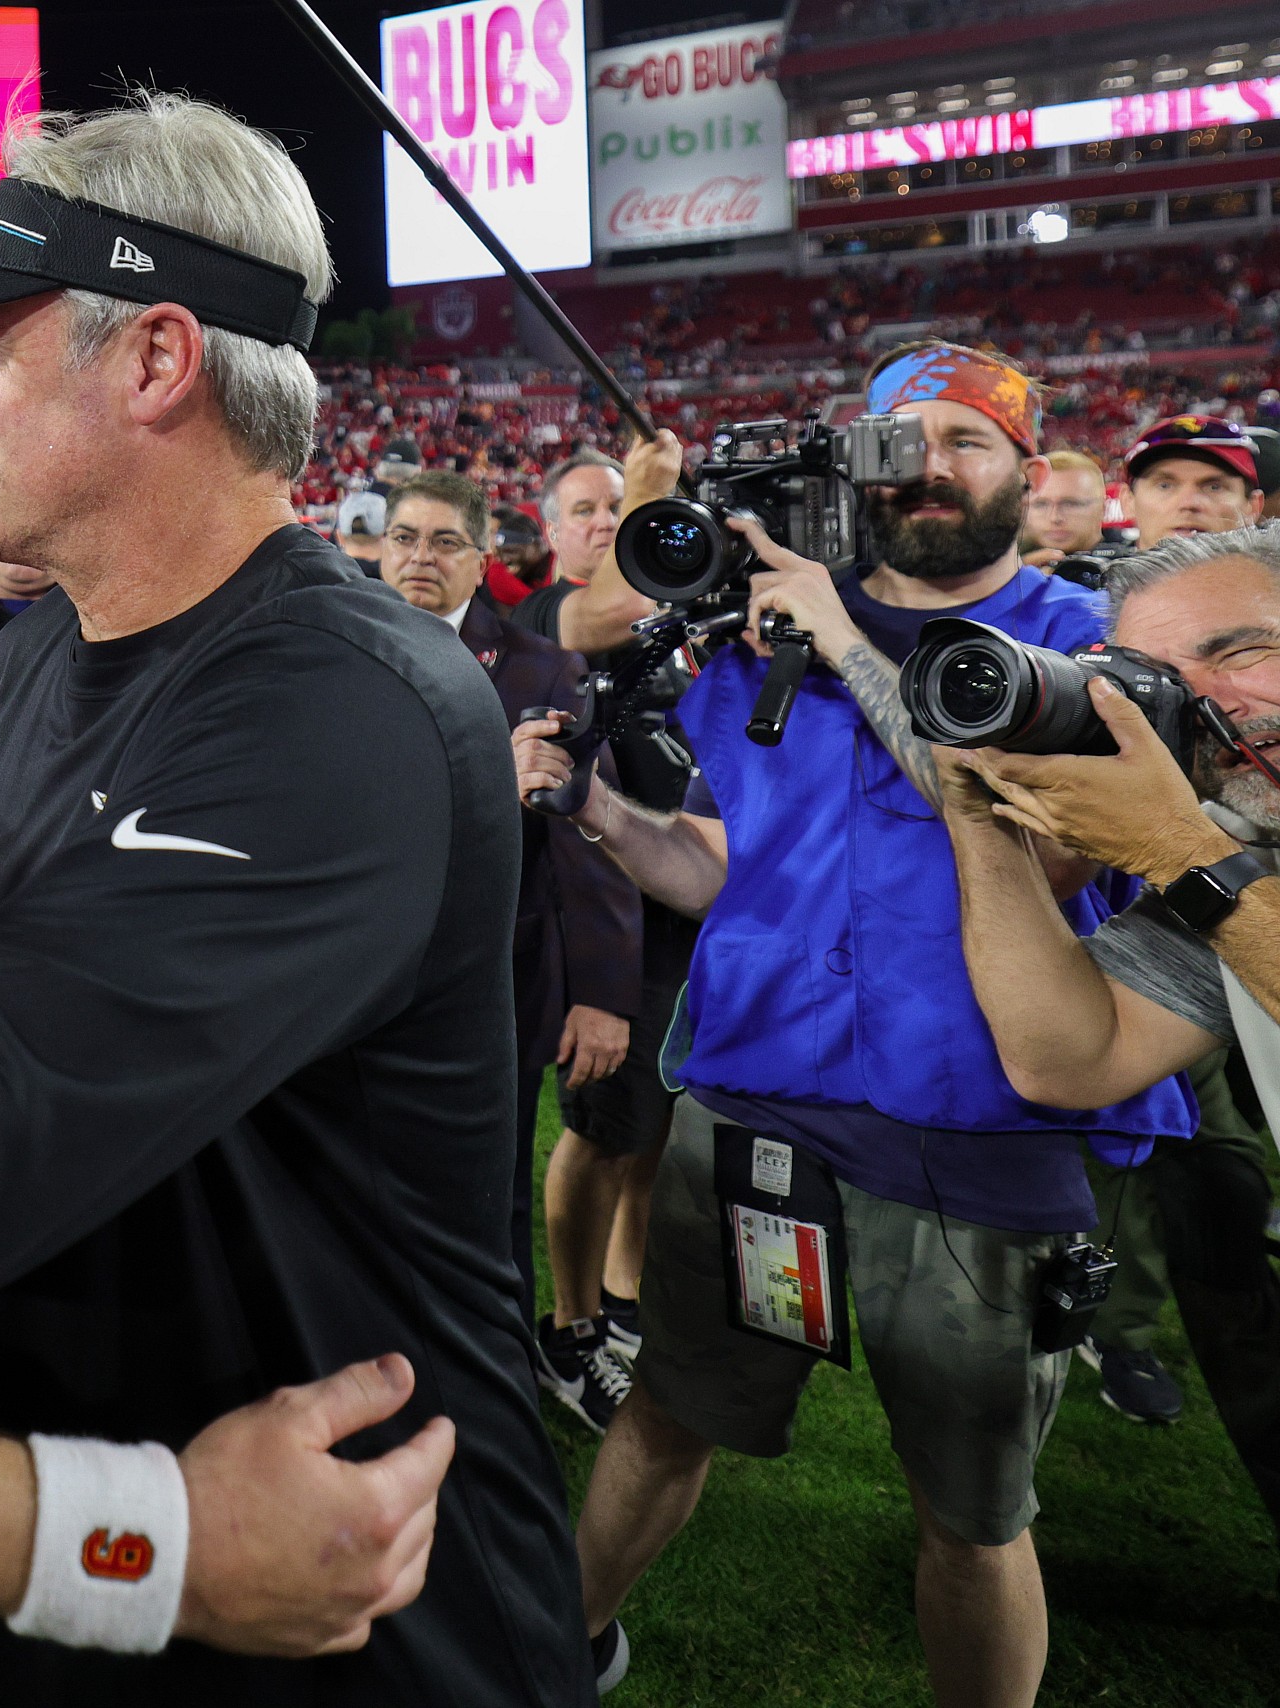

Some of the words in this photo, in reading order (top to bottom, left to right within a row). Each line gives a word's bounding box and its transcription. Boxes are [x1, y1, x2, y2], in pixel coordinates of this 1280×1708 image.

[391, 0, 574, 147] BUCS
[643, 55, 680, 99] GO
[599, 116, 763, 168] Publix
[431, 135, 536, 205] WIN
[1075, 652, 1113, 664] Canon
[1135, 673, 1155, 682] EOS
[1136, 683, 1152, 693] R3
[757, 1154, 788, 1170] FLEX
